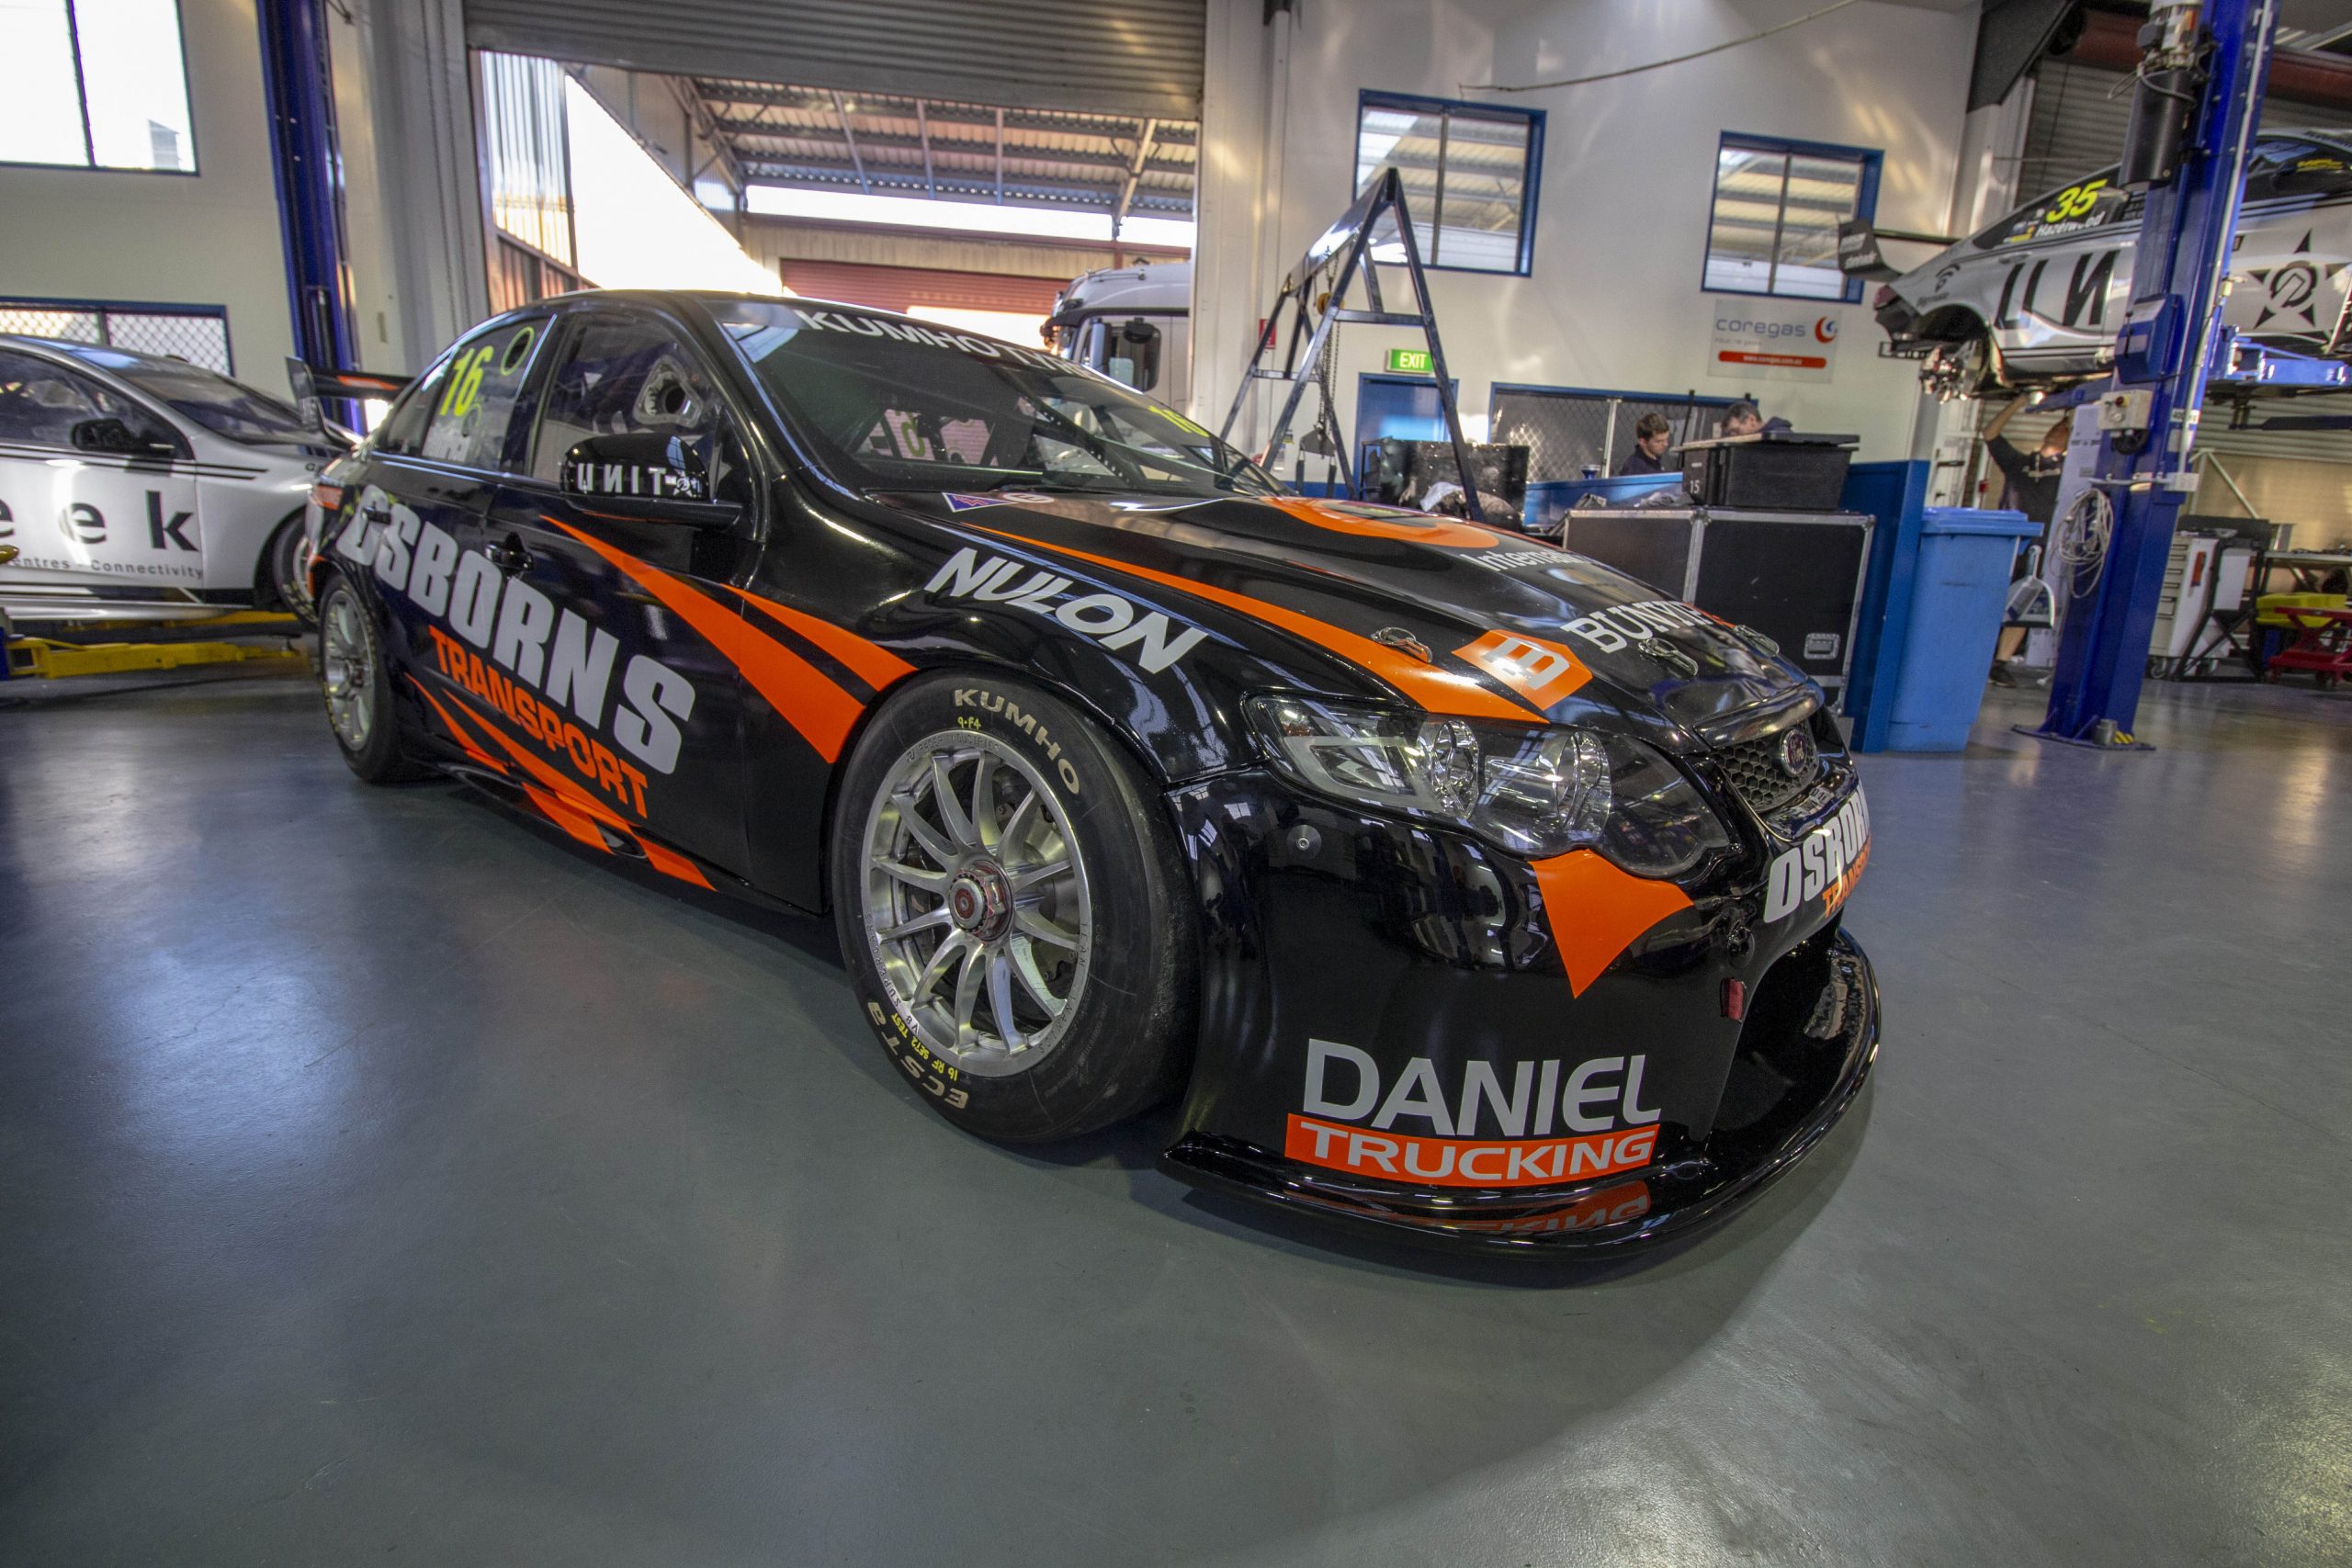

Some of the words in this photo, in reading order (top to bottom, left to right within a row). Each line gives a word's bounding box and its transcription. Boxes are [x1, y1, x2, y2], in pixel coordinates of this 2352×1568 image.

[2046, 179, 2108, 223] 35
[793, 309, 1001, 358] KUMHO
[1715, 318, 1807, 339] coregas
[440, 344, 495, 417] 16
[1398, 351, 1427, 369] EXIT
[1690, 479, 1701, 494] 15
[91, 558, 204, 581] Connectivity
[336, 483, 695, 774] OSBORNS
[922, 547, 1209, 674] NULON
[429, 625, 649, 819] TRANSPORT
[955, 689, 1080, 795] KUMHO
[890, 1011, 910, 1039] TEST
[867, 1001, 969, 1110] ECSTA
[931, 1058, 945, 1075] RF
[1303, 1038, 1662, 1137] DANIEL
[1300, 1121, 1656, 1180] TRUCKING
